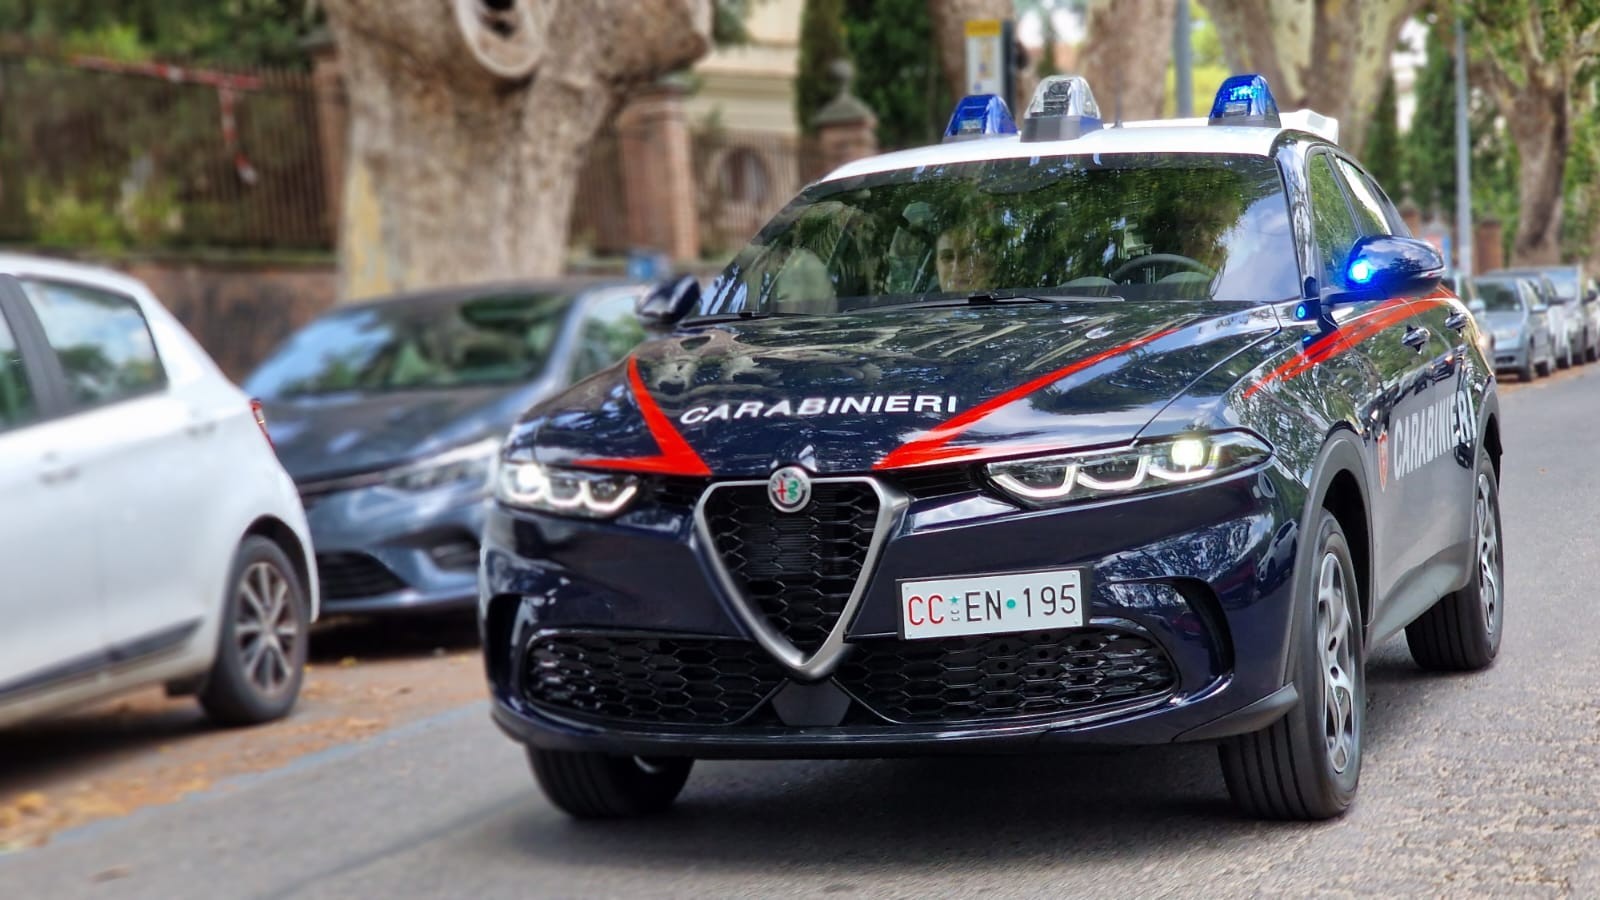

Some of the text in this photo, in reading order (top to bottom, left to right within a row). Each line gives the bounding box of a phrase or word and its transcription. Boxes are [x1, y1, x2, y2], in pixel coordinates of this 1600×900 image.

[680, 395, 957, 424] CARABINIERI
[1394, 387, 1476, 480] CARABINIERI
[908, 584, 1076, 625] CC EN 195
